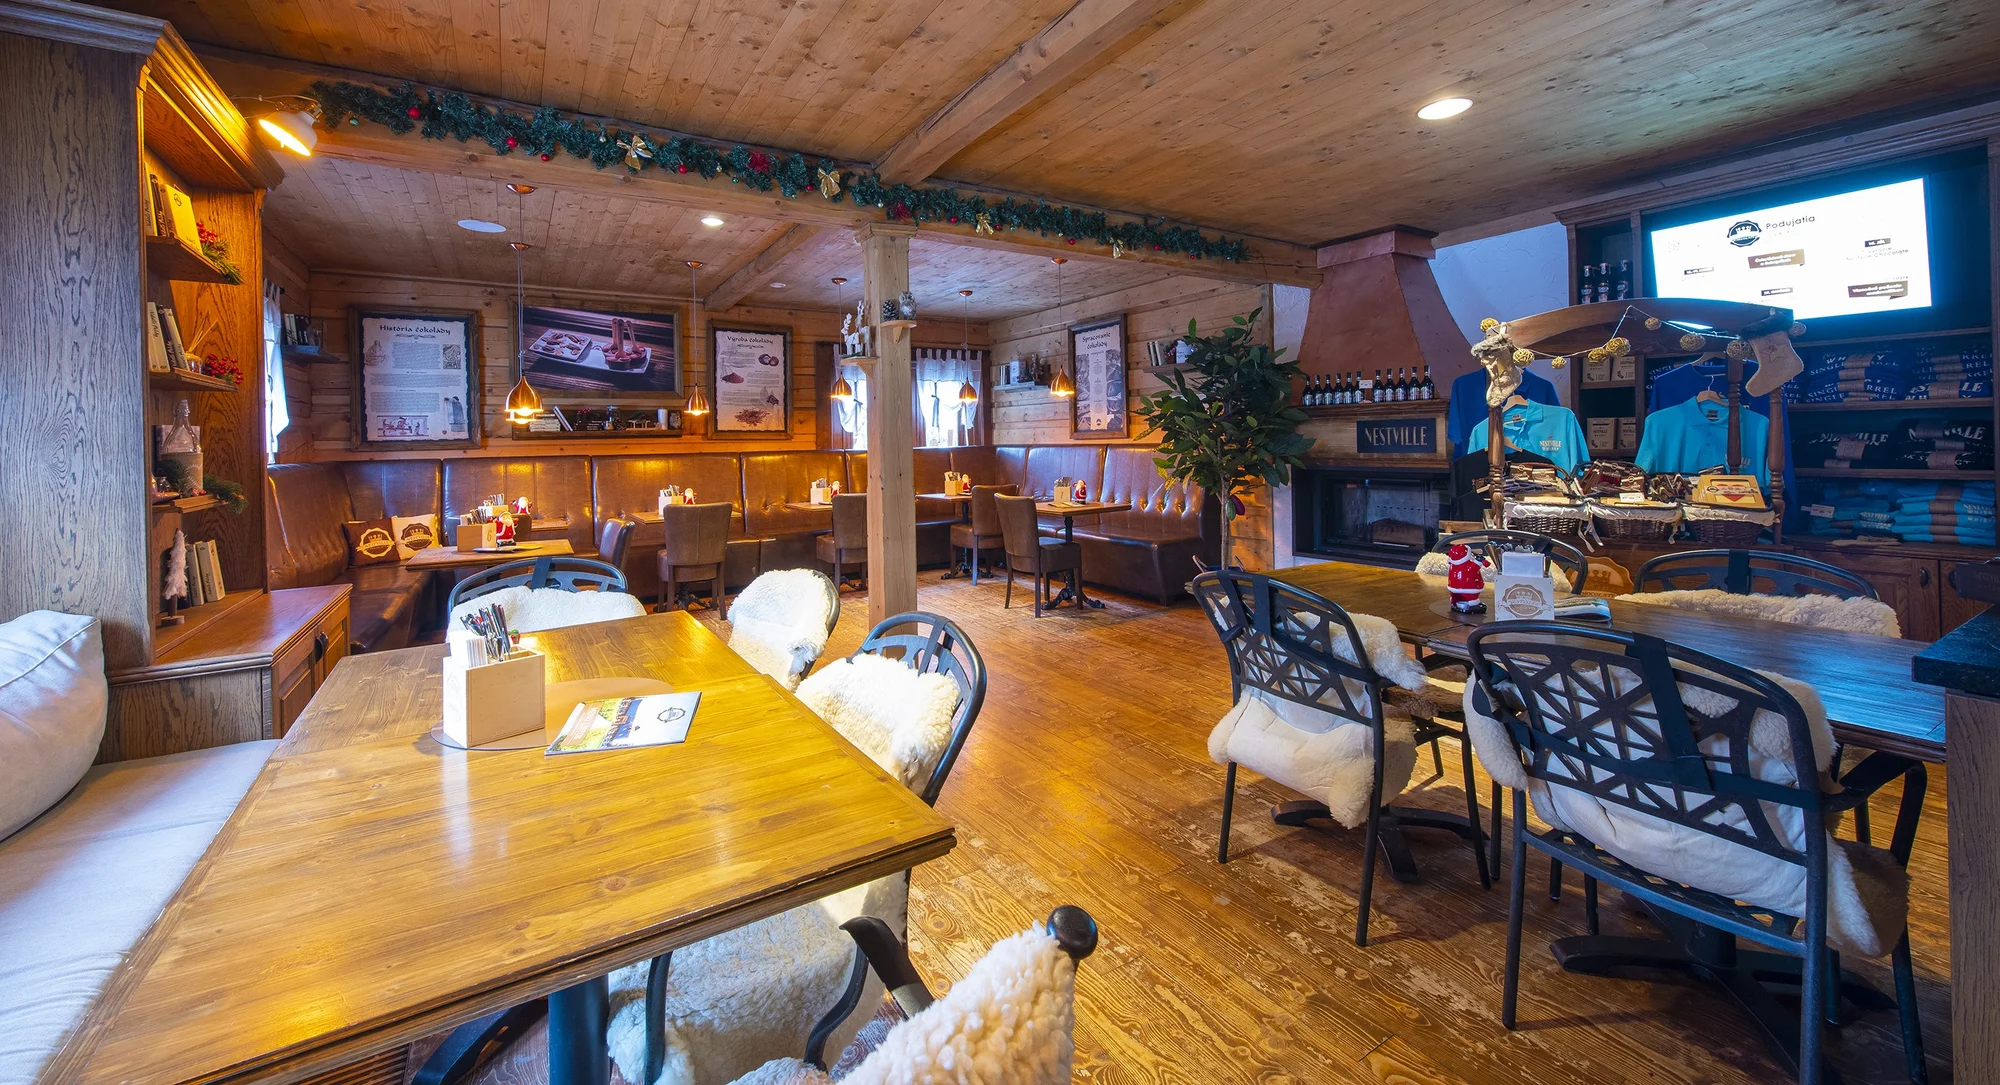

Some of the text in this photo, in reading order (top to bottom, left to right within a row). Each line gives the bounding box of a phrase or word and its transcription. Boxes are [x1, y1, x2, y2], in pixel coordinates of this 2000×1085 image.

[1765, 215, 1816, 230] Podujatia
[380, 325, 413, 333] História
[1082, 331, 1111, 344] Spracovanie
[1364, 426, 1428, 446] NESTVILLE
[486, 530, 493, 542] 6
